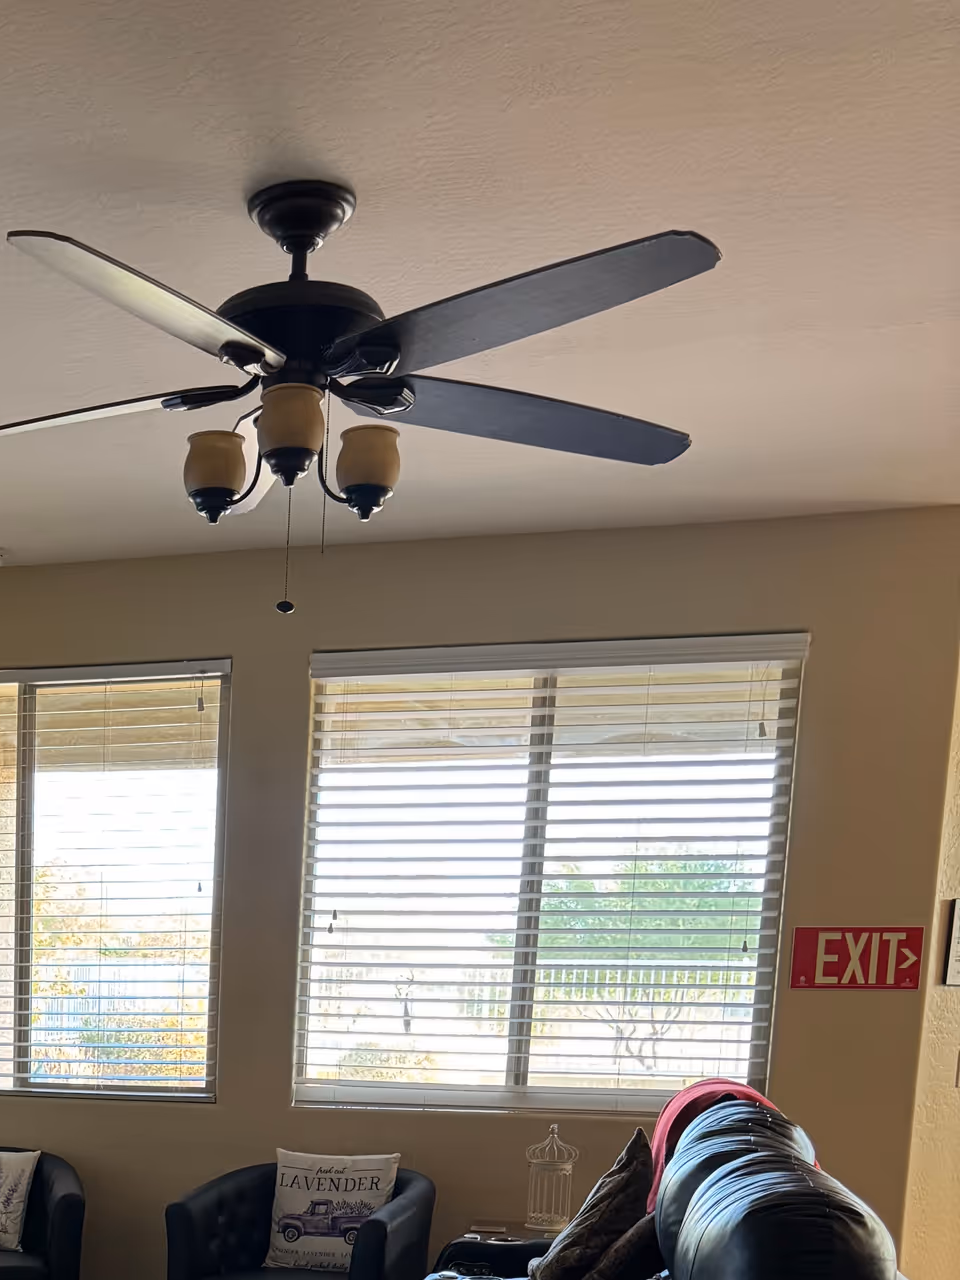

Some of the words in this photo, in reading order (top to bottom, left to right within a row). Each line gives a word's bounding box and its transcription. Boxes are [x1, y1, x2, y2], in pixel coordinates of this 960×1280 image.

[814, 932, 907, 985] EXIT
[316, 1167, 334, 1175] fresh
[280, 1173, 381, 1192] LAVENDER
